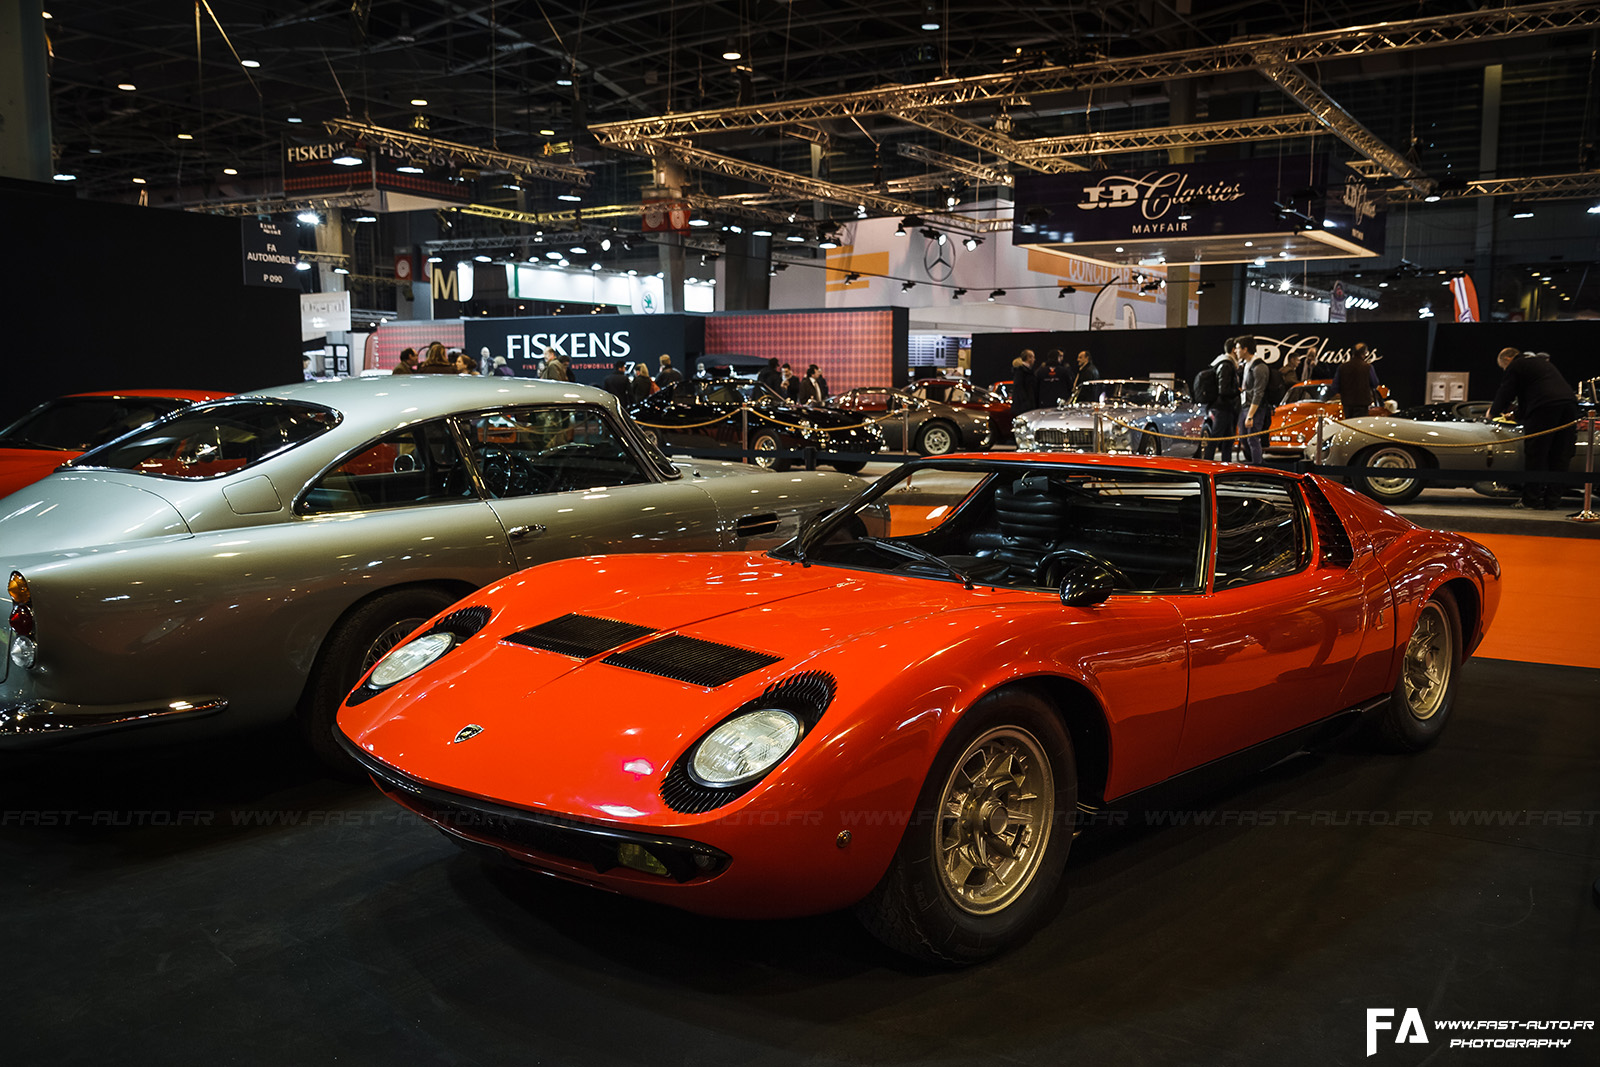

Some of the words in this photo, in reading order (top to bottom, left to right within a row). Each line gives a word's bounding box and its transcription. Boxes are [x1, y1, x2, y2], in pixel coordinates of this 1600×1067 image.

[1131, 222, 1188, 234] MAYFAIR
[266, 243, 277, 252] FA
[247, 252, 296, 265] AUTOMOBILE
[263, 273, 269, 282] P
[269, 274, 283, 283] 090
[434, 268, 458, 301] M
[506, 331, 631, 359] FISKENS
[1269, 333, 1383, 367] Classs
[571, 362, 614, 370] AUTOMOBILES
